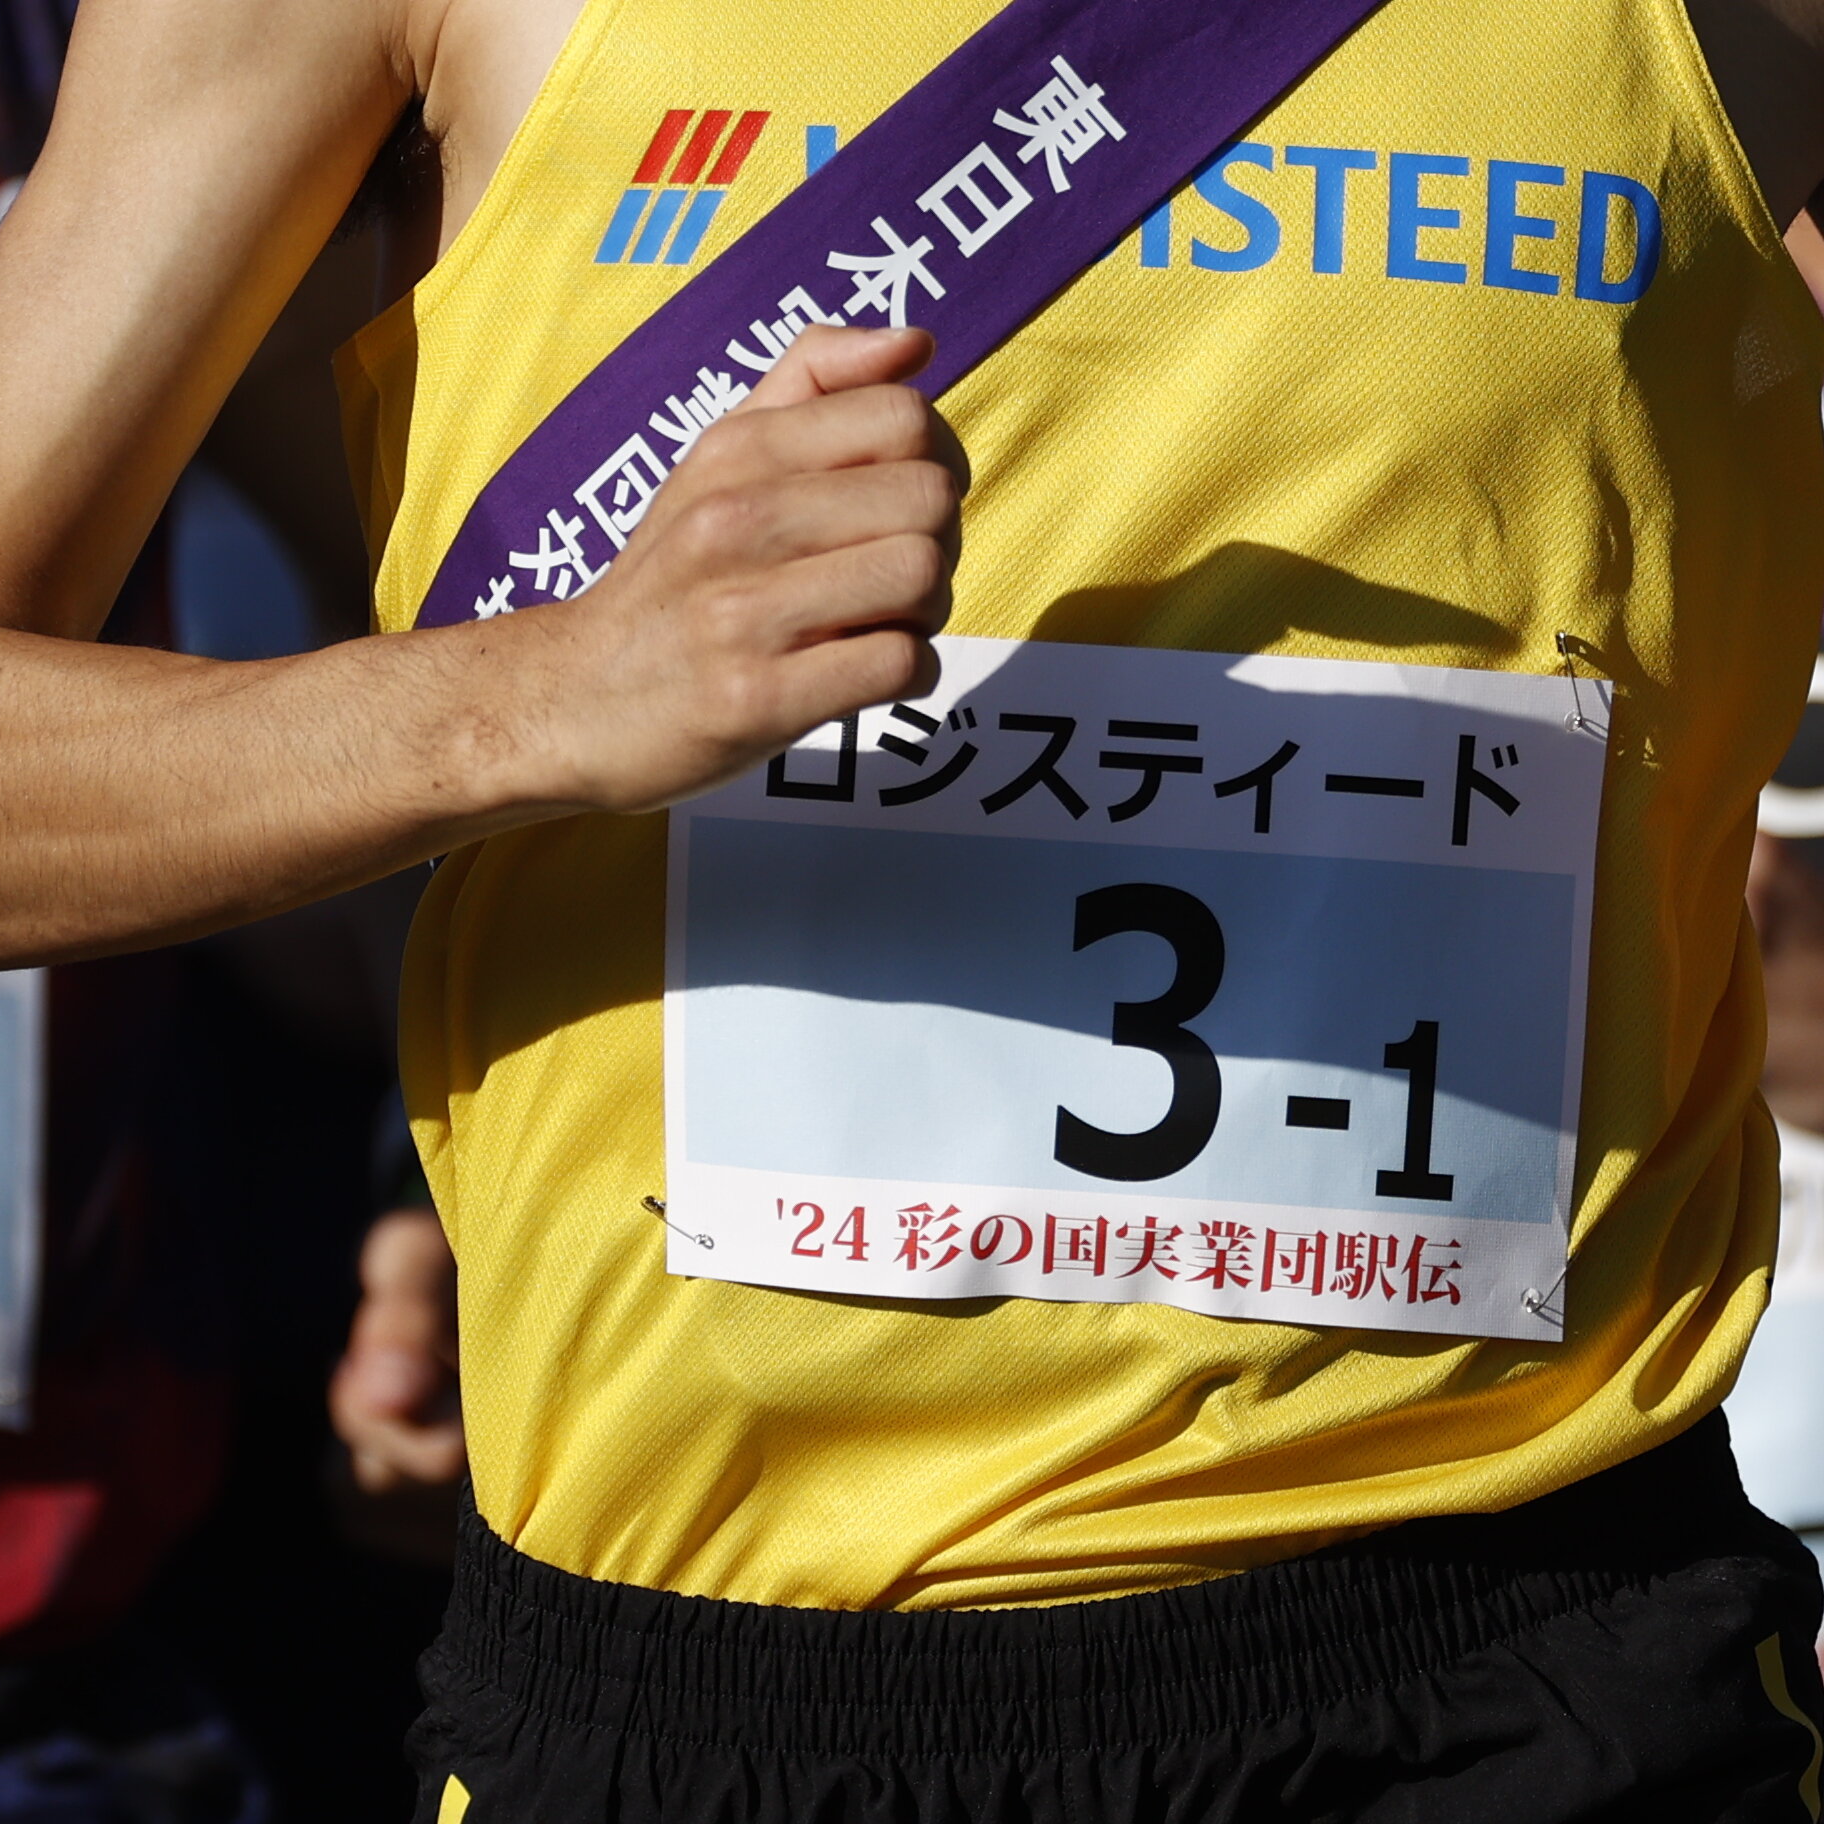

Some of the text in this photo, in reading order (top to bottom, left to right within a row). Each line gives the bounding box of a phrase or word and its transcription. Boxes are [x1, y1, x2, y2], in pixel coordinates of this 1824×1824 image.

[765, 701, 1522, 847] ロジスティード
[1054, 882, 1455, 1203] 3-1
[895, 1199, 1462, 1307] 彩の国実業団駅伝
